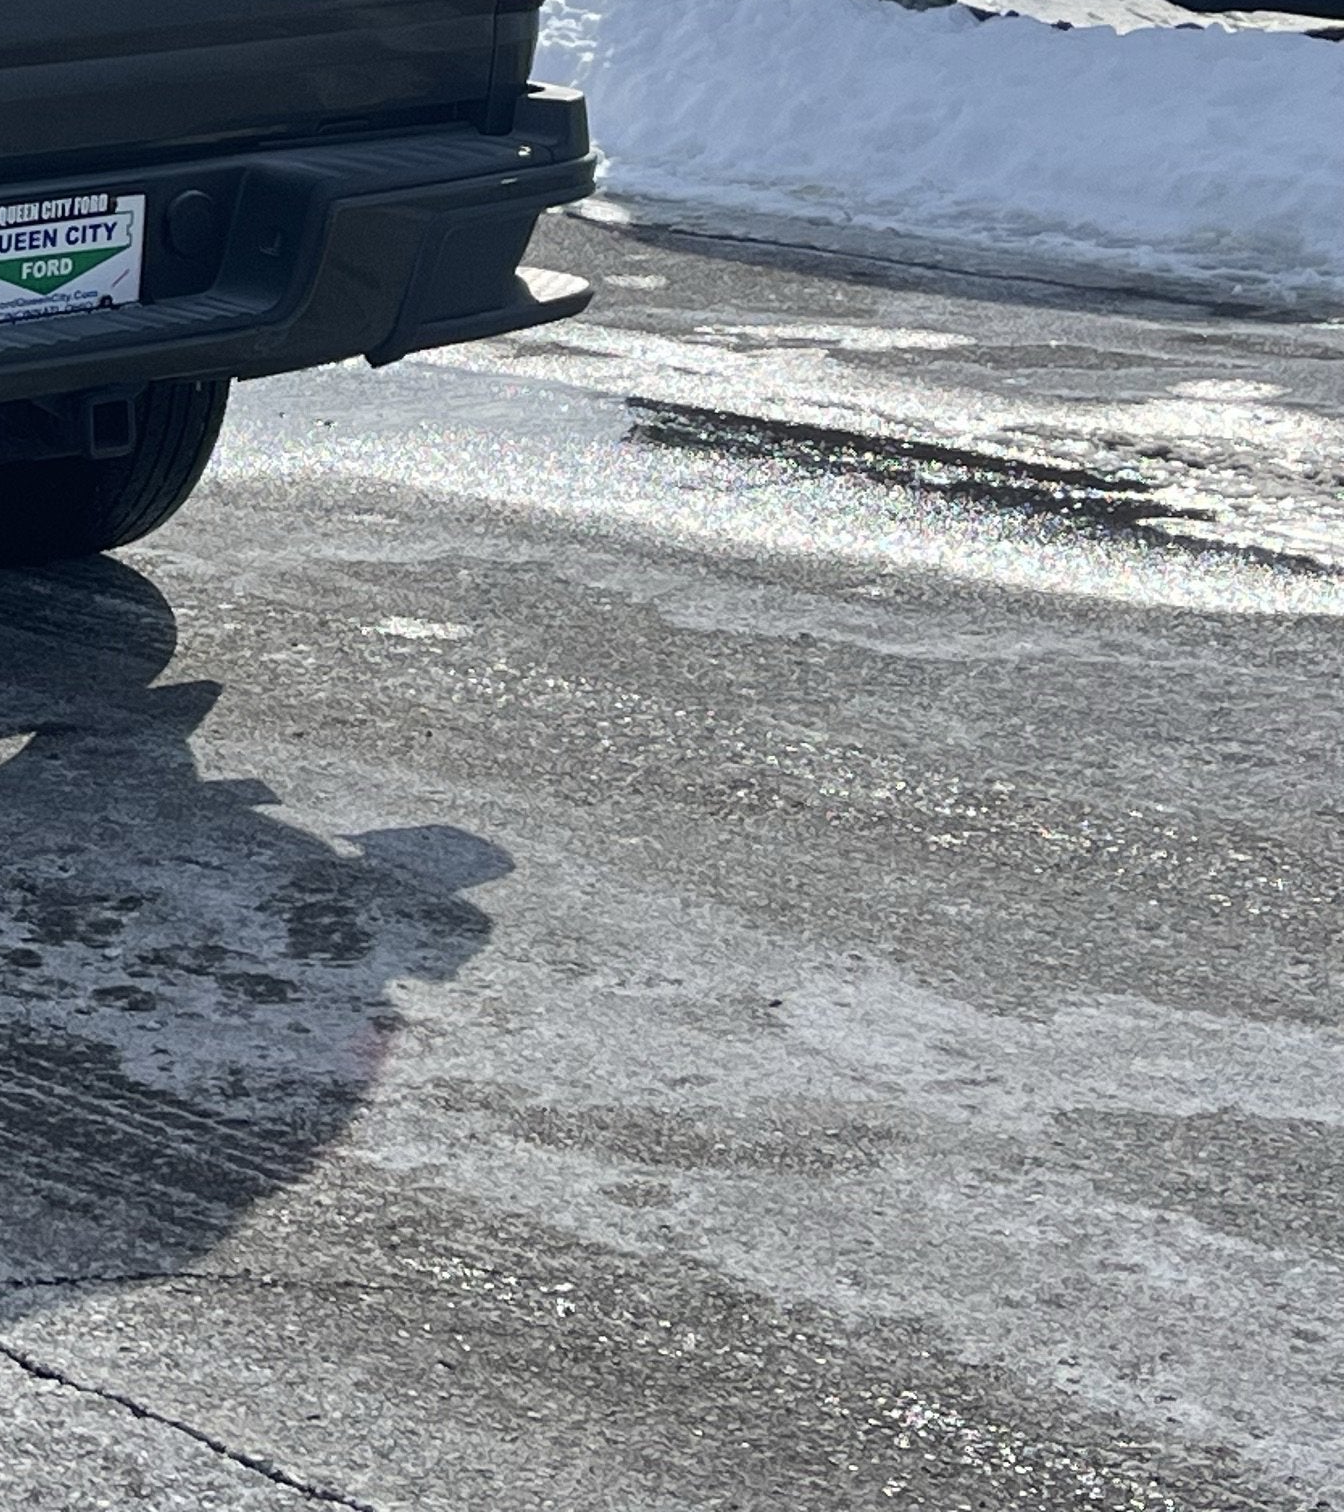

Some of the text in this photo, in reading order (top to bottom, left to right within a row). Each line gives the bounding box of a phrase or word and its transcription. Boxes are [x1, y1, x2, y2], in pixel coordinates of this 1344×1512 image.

[41, 197, 72, 220] CITY
[73, 193, 108, 216] FORD
[65, 222, 117, 246] CITY
[21, 257, 73, 280] FORD
